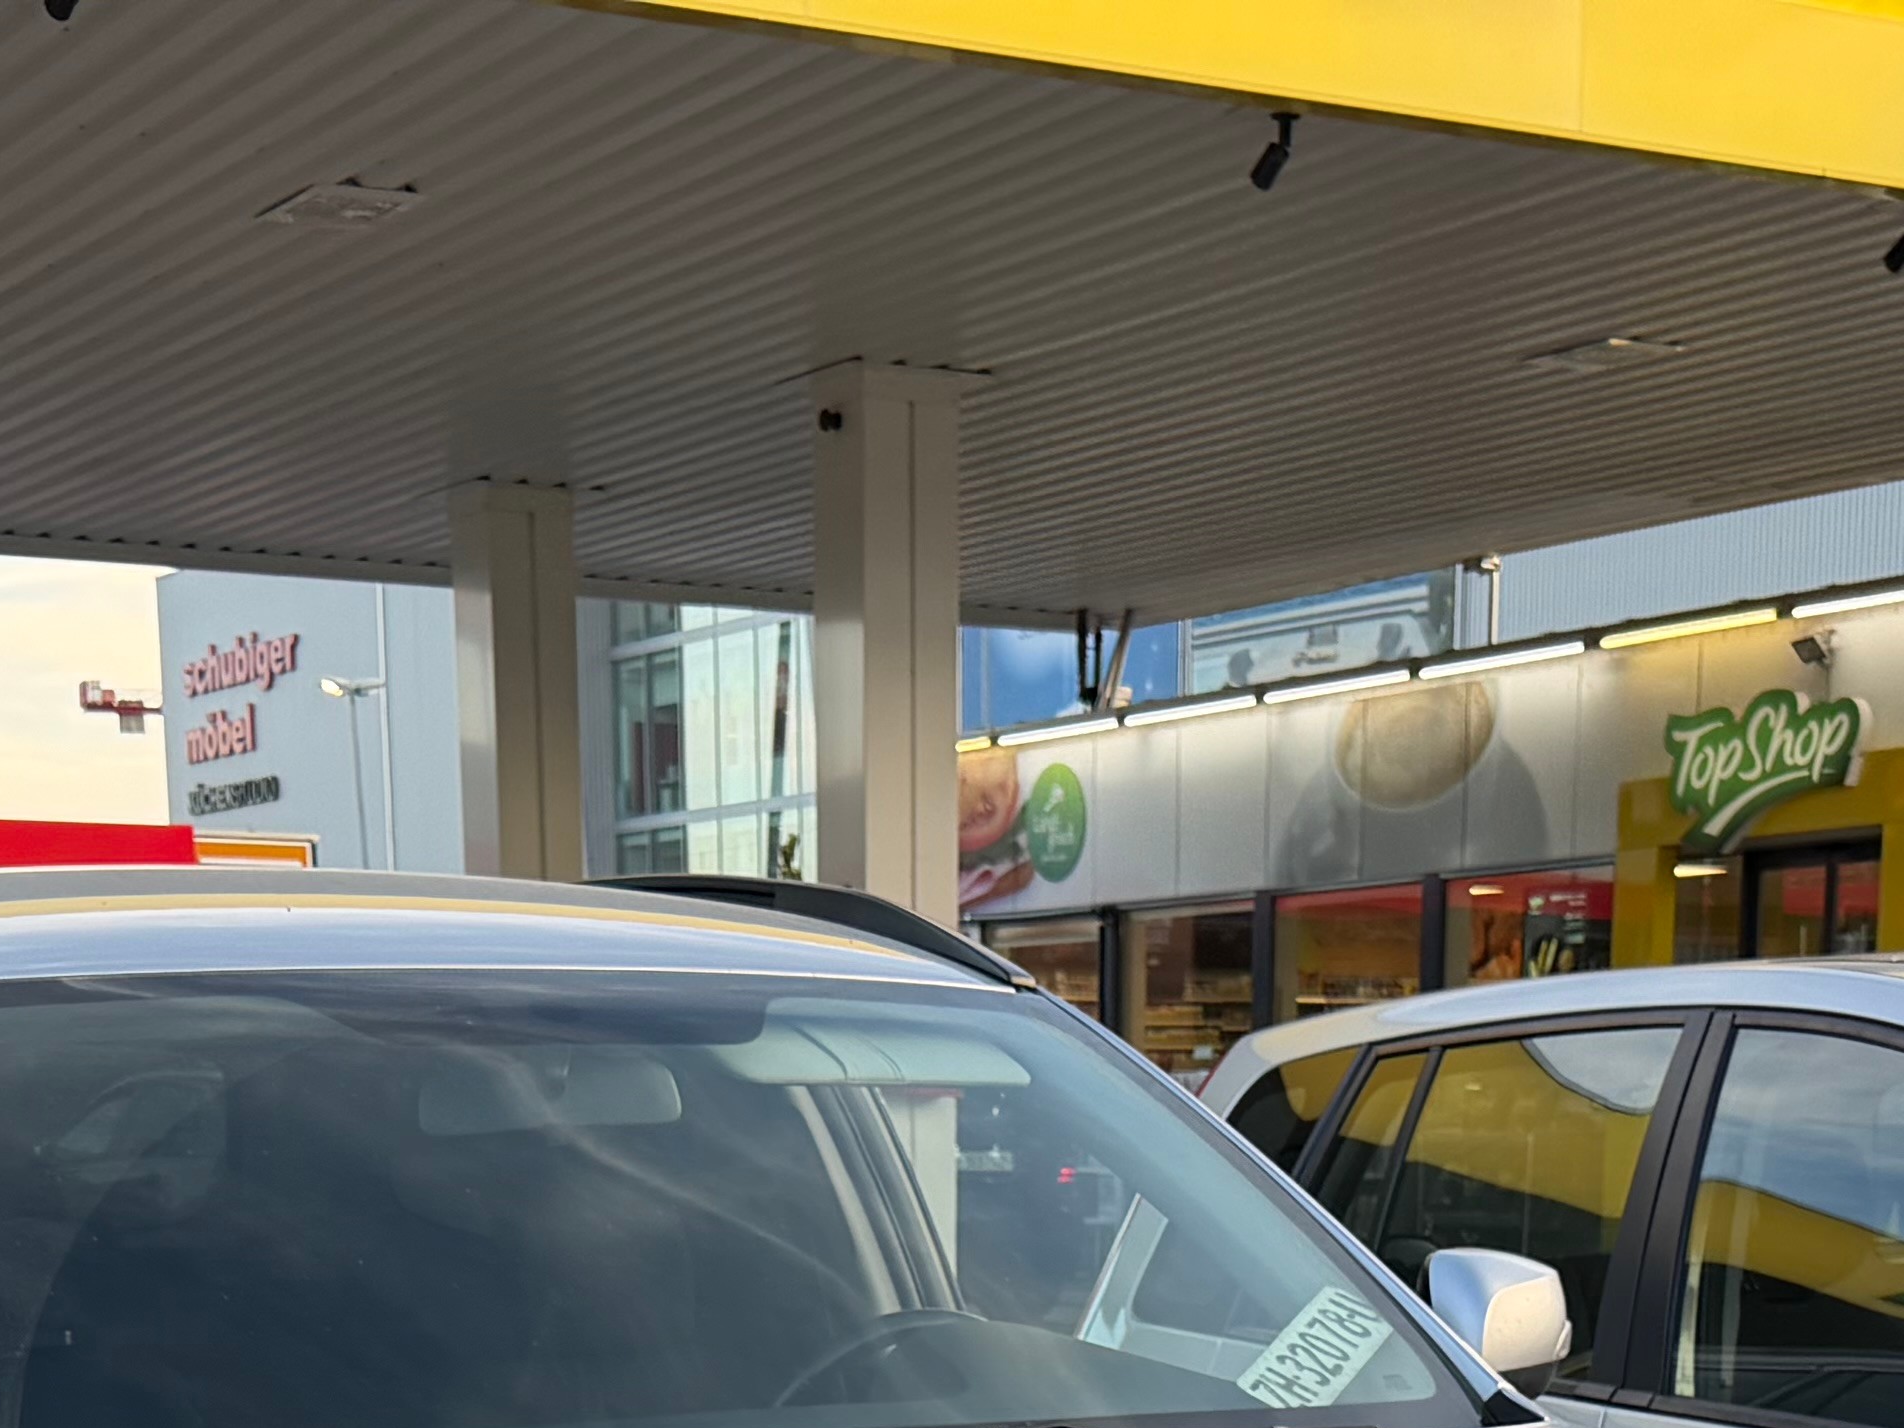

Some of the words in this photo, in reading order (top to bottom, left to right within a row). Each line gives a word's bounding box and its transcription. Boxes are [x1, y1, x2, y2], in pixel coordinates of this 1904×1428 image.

[184, 631, 299, 697] schubiger
[186, 703, 257, 766] möbel
[1671, 702, 1850, 806] TopShop
